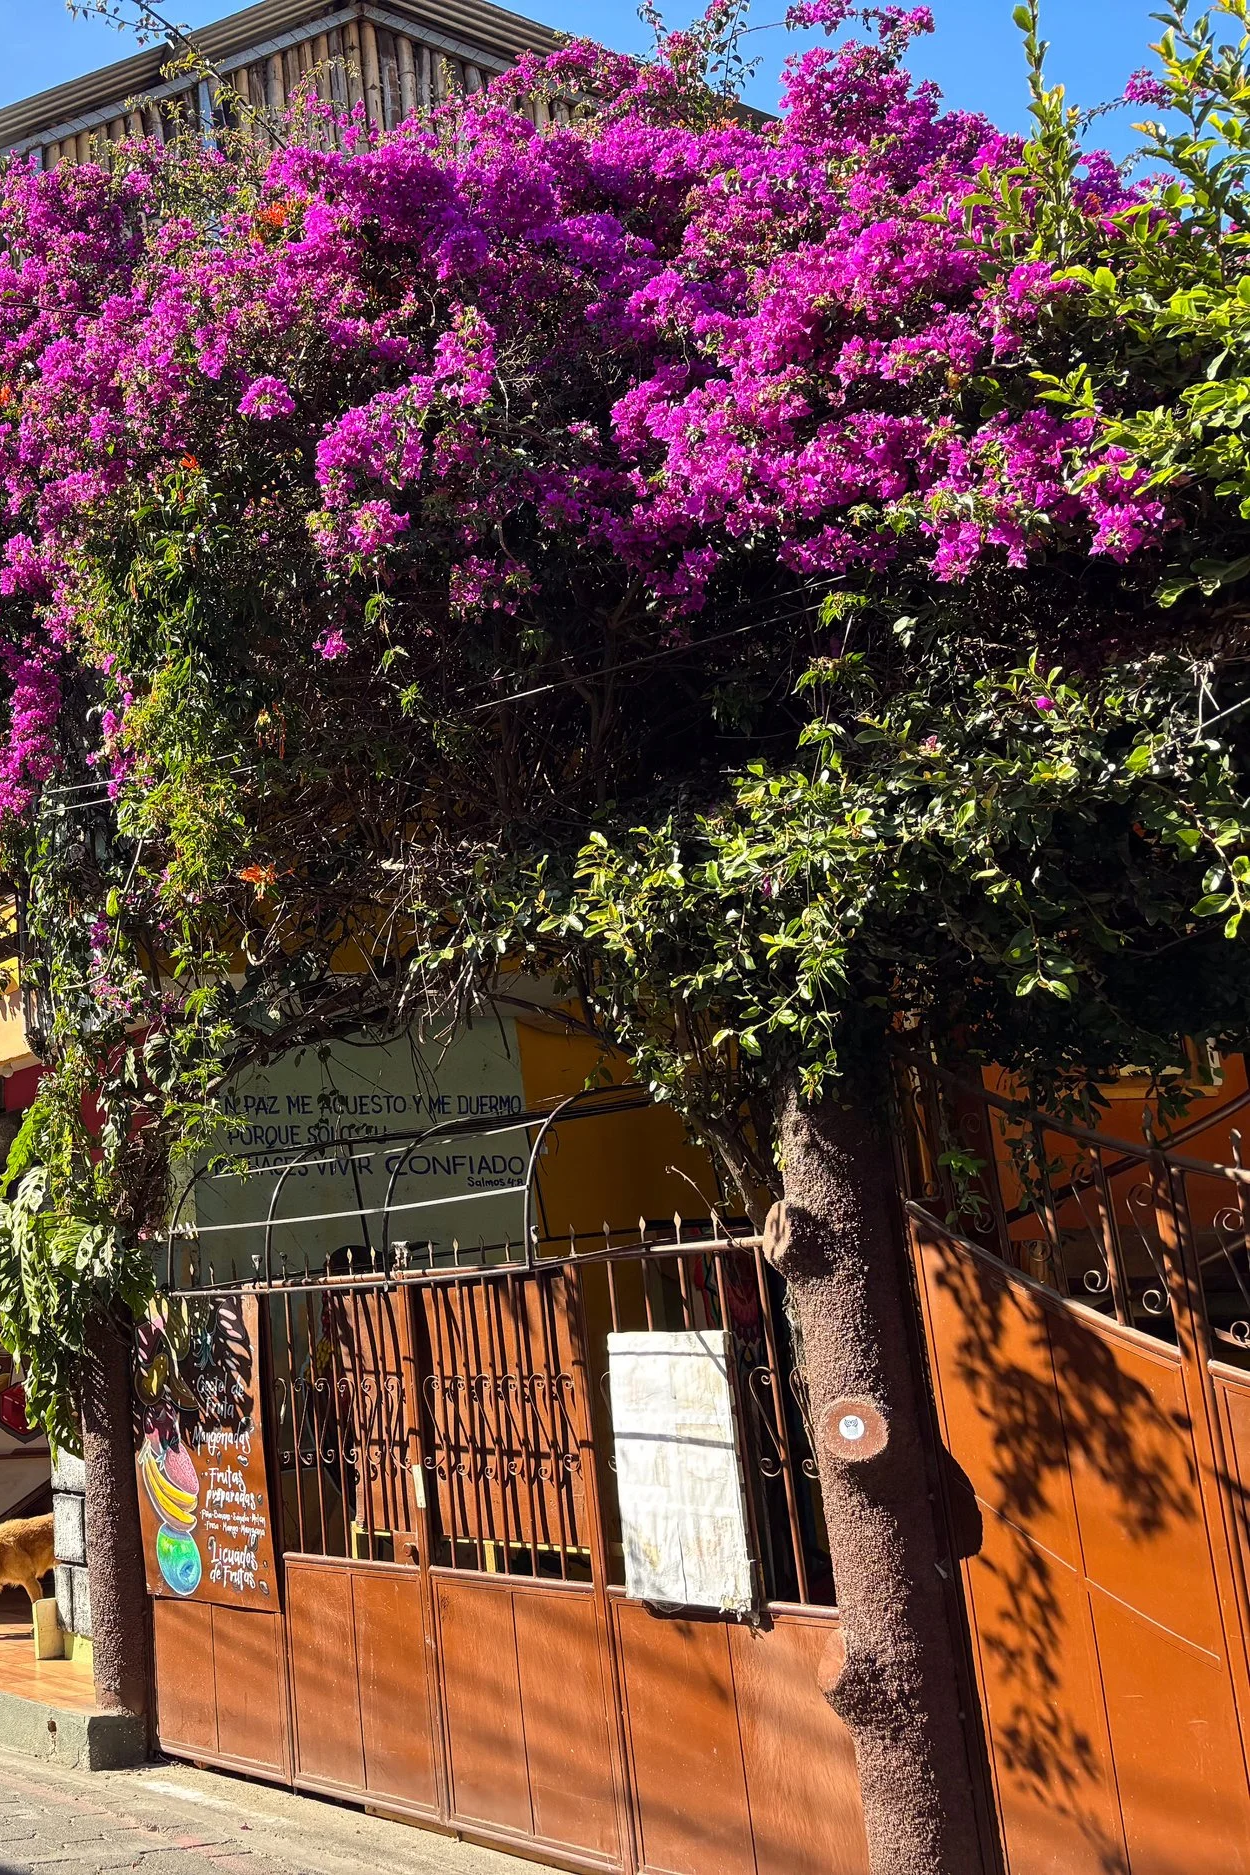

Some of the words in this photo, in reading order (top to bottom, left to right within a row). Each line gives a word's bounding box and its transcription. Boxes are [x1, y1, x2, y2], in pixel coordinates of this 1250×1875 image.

[243, 1095, 280, 1116] PAZ
[287, 1095, 313, 1115] ME
[319, 1094, 407, 1115] ACUESTO
[411, 1095, 423, 1114] Y
[428, 1095, 452, 1114] ME
[457, 1095, 522, 1115] DUERMO
[227, 1125, 302, 1149] PORQUE
[384, 1155, 525, 1176] CONFIADO
[467, 1177, 505, 1188] Salmos
[230, 1374, 245, 1396] de
[205, 1396, 235, 1419] Fruta
[208, 1465, 247, 1493] Frutas
[205, 1488, 256, 1510] preparadas
[210, 1541, 258, 1570] Licuados
[209, 1562, 221, 1583] de
[222, 1565, 256, 1591] Frutas
